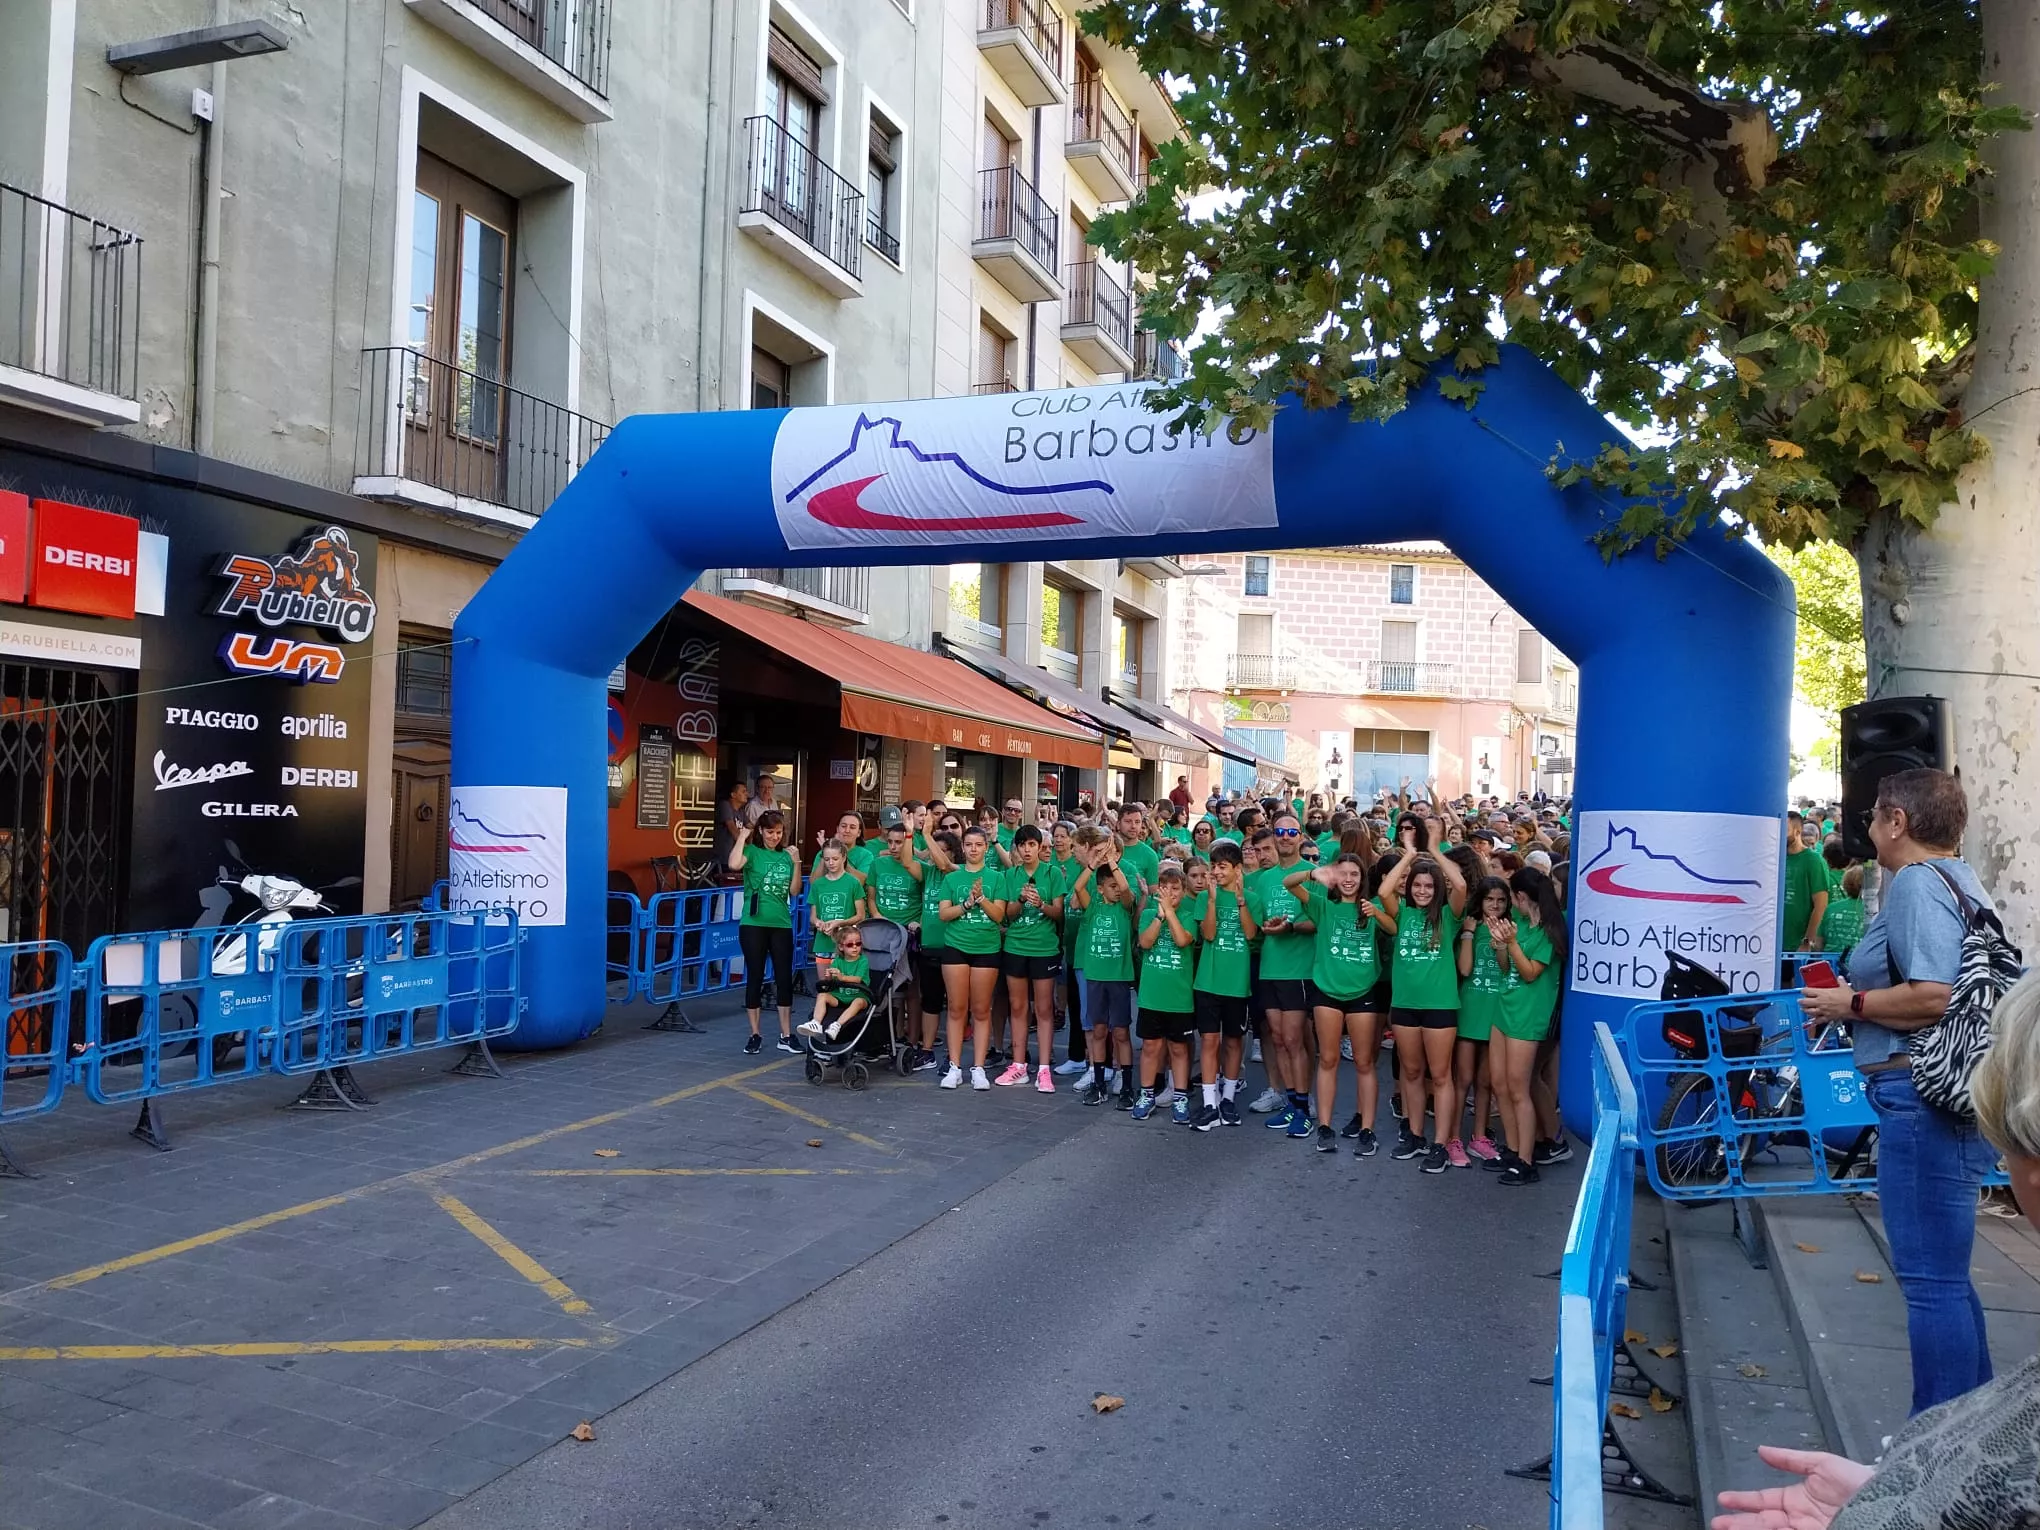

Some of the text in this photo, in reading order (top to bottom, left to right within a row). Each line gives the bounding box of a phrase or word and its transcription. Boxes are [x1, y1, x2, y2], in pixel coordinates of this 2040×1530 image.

[1011, 393, 1091, 417] Club
[1005, 419, 1257, 463] Barbasro
[45, 545, 131, 576] DERBI
[218, 555, 371, 633] Rubiella
[0, 632, 136, 657] PARUBIELLA.COM
[677, 637, 720, 743] BAR
[166, 707, 347, 740] PIAGGIO aprilia
[952, 728, 963, 743] BAR
[154, 749, 358, 791] Vespa DERBI
[201, 802, 299, 817] GILERA
[461, 869, 549, 888] Atletismo
[1578, 920, 1762, 954] Club Atletismo
[1577, 952, 1761, 993] Barbtro
[235, 995, 272, 1006] BARBAST
